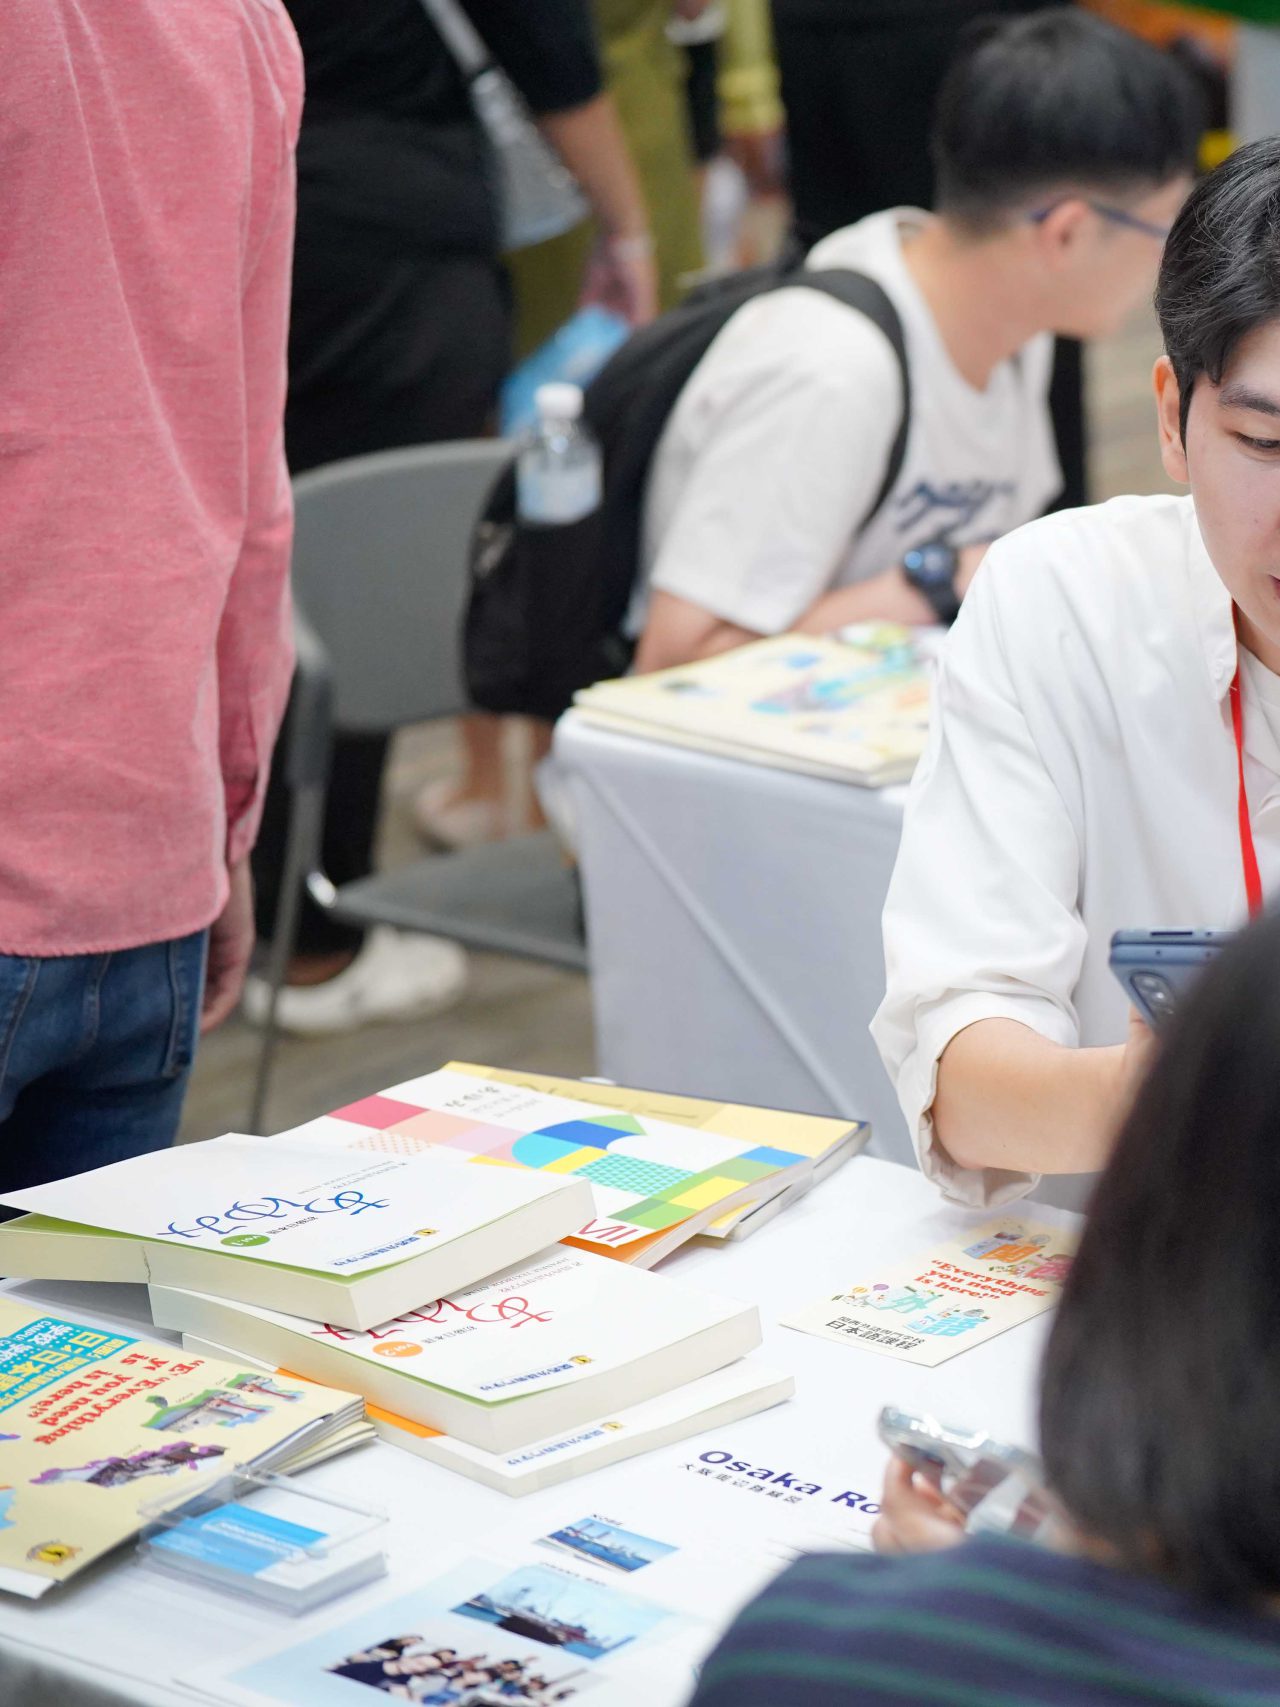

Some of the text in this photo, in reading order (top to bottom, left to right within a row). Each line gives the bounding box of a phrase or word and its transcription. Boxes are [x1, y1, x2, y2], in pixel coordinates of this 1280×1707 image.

[914, 1275, 933, 1284] is
[925, 1270, 1017, 1296] you need
[84, 1369, 113, 1380] is
[38, 1374, 134, 1427] you need
[698, 1451, 823, 1495] Osaka
